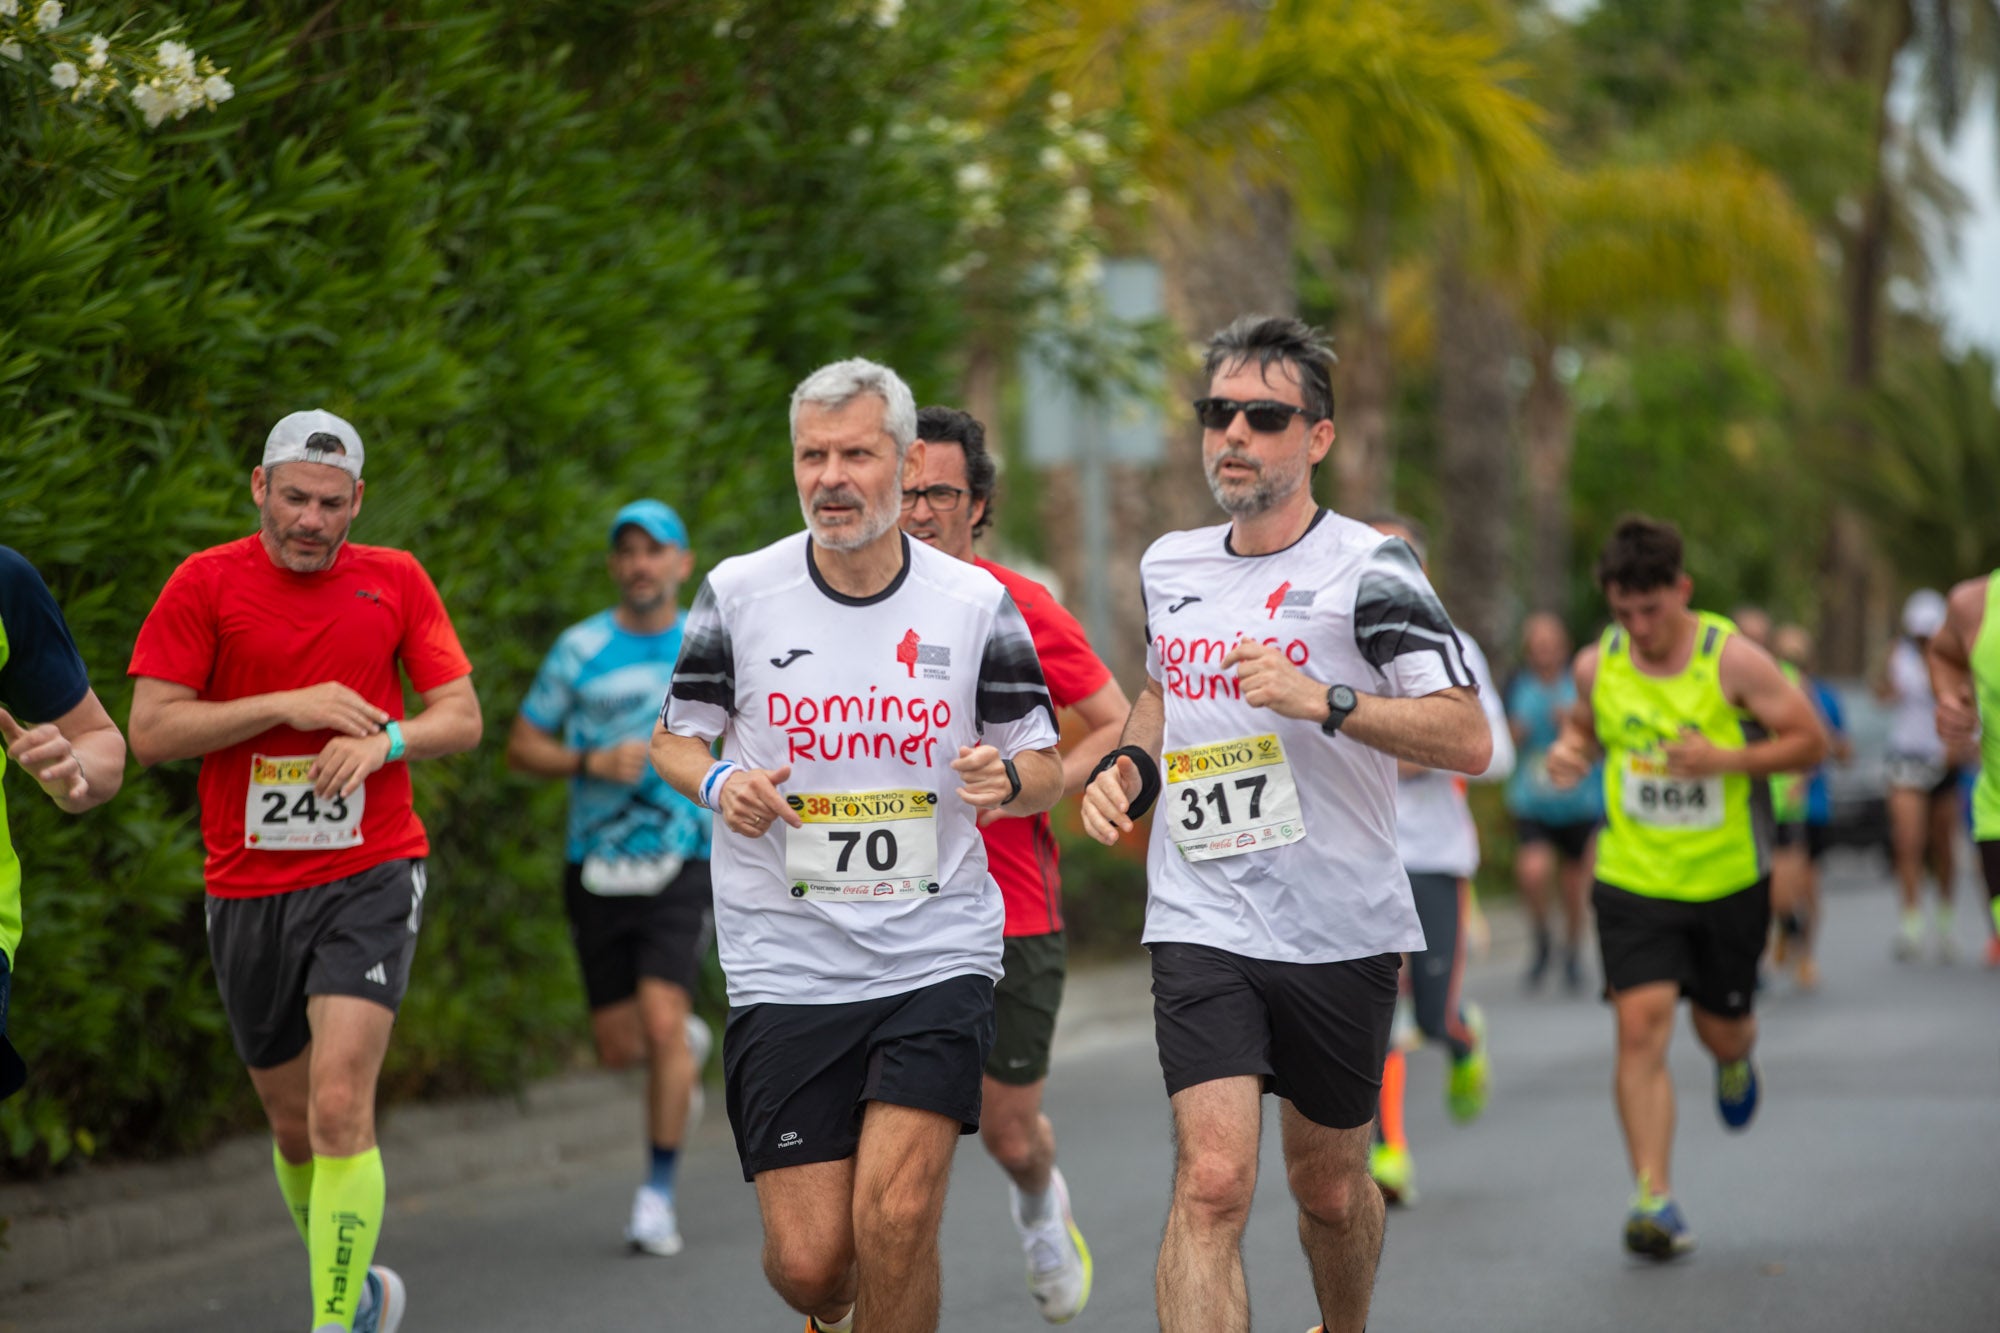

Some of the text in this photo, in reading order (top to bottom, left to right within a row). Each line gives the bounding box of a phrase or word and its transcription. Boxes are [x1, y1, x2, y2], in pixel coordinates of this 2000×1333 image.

[768, 685, 951, 740] Domingo
[785, 726, 937, 767] Runner
[1177, 754, 1190, 773] 38
[261, 789, 348, 824] 243
[807, 797, 831, 816] 38
[831, 799, 904, 817] FONDO
[834, 795, 862, 803] GRAN
[864, 793, 897, 802] PREMIO
[1181, 774, 1268, 830] 317
[828, 829, 898, 872] 70
[810, 883, 841, 892] Cruzcampo
